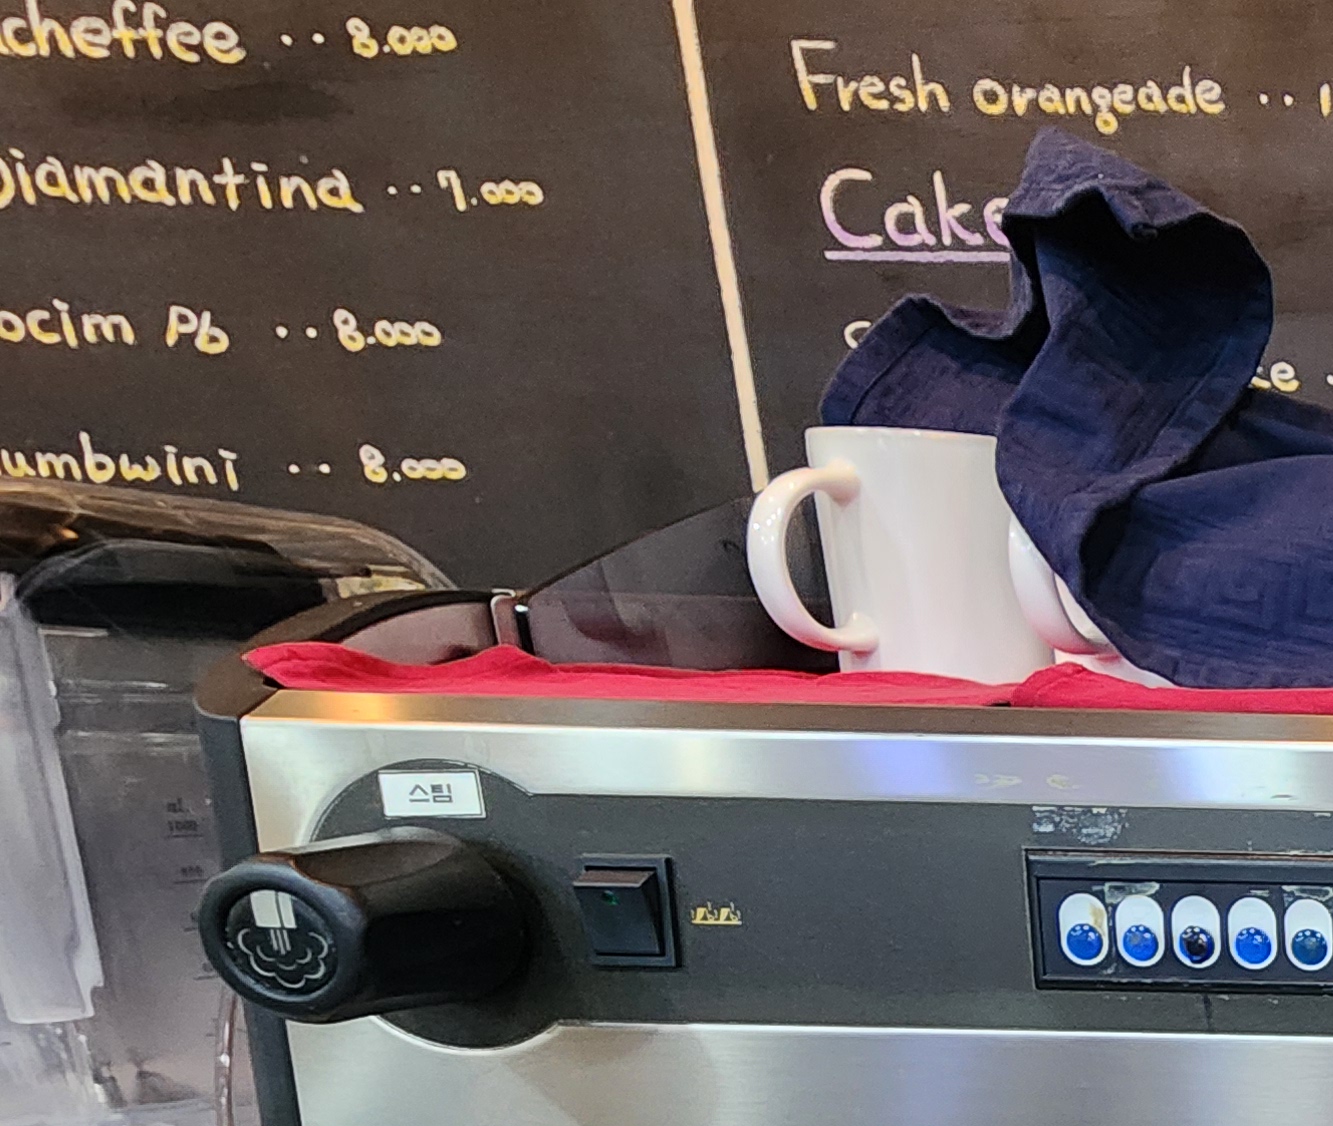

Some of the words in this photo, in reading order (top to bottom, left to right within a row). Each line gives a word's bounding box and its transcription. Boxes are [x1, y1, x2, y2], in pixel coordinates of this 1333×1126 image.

[0, 0, 247, 64] cheffee
[791, 39, 950, 113] Fresh
[973, 66, 1224, 135] orangeade
[408, 782, 453, 804] 스팀
